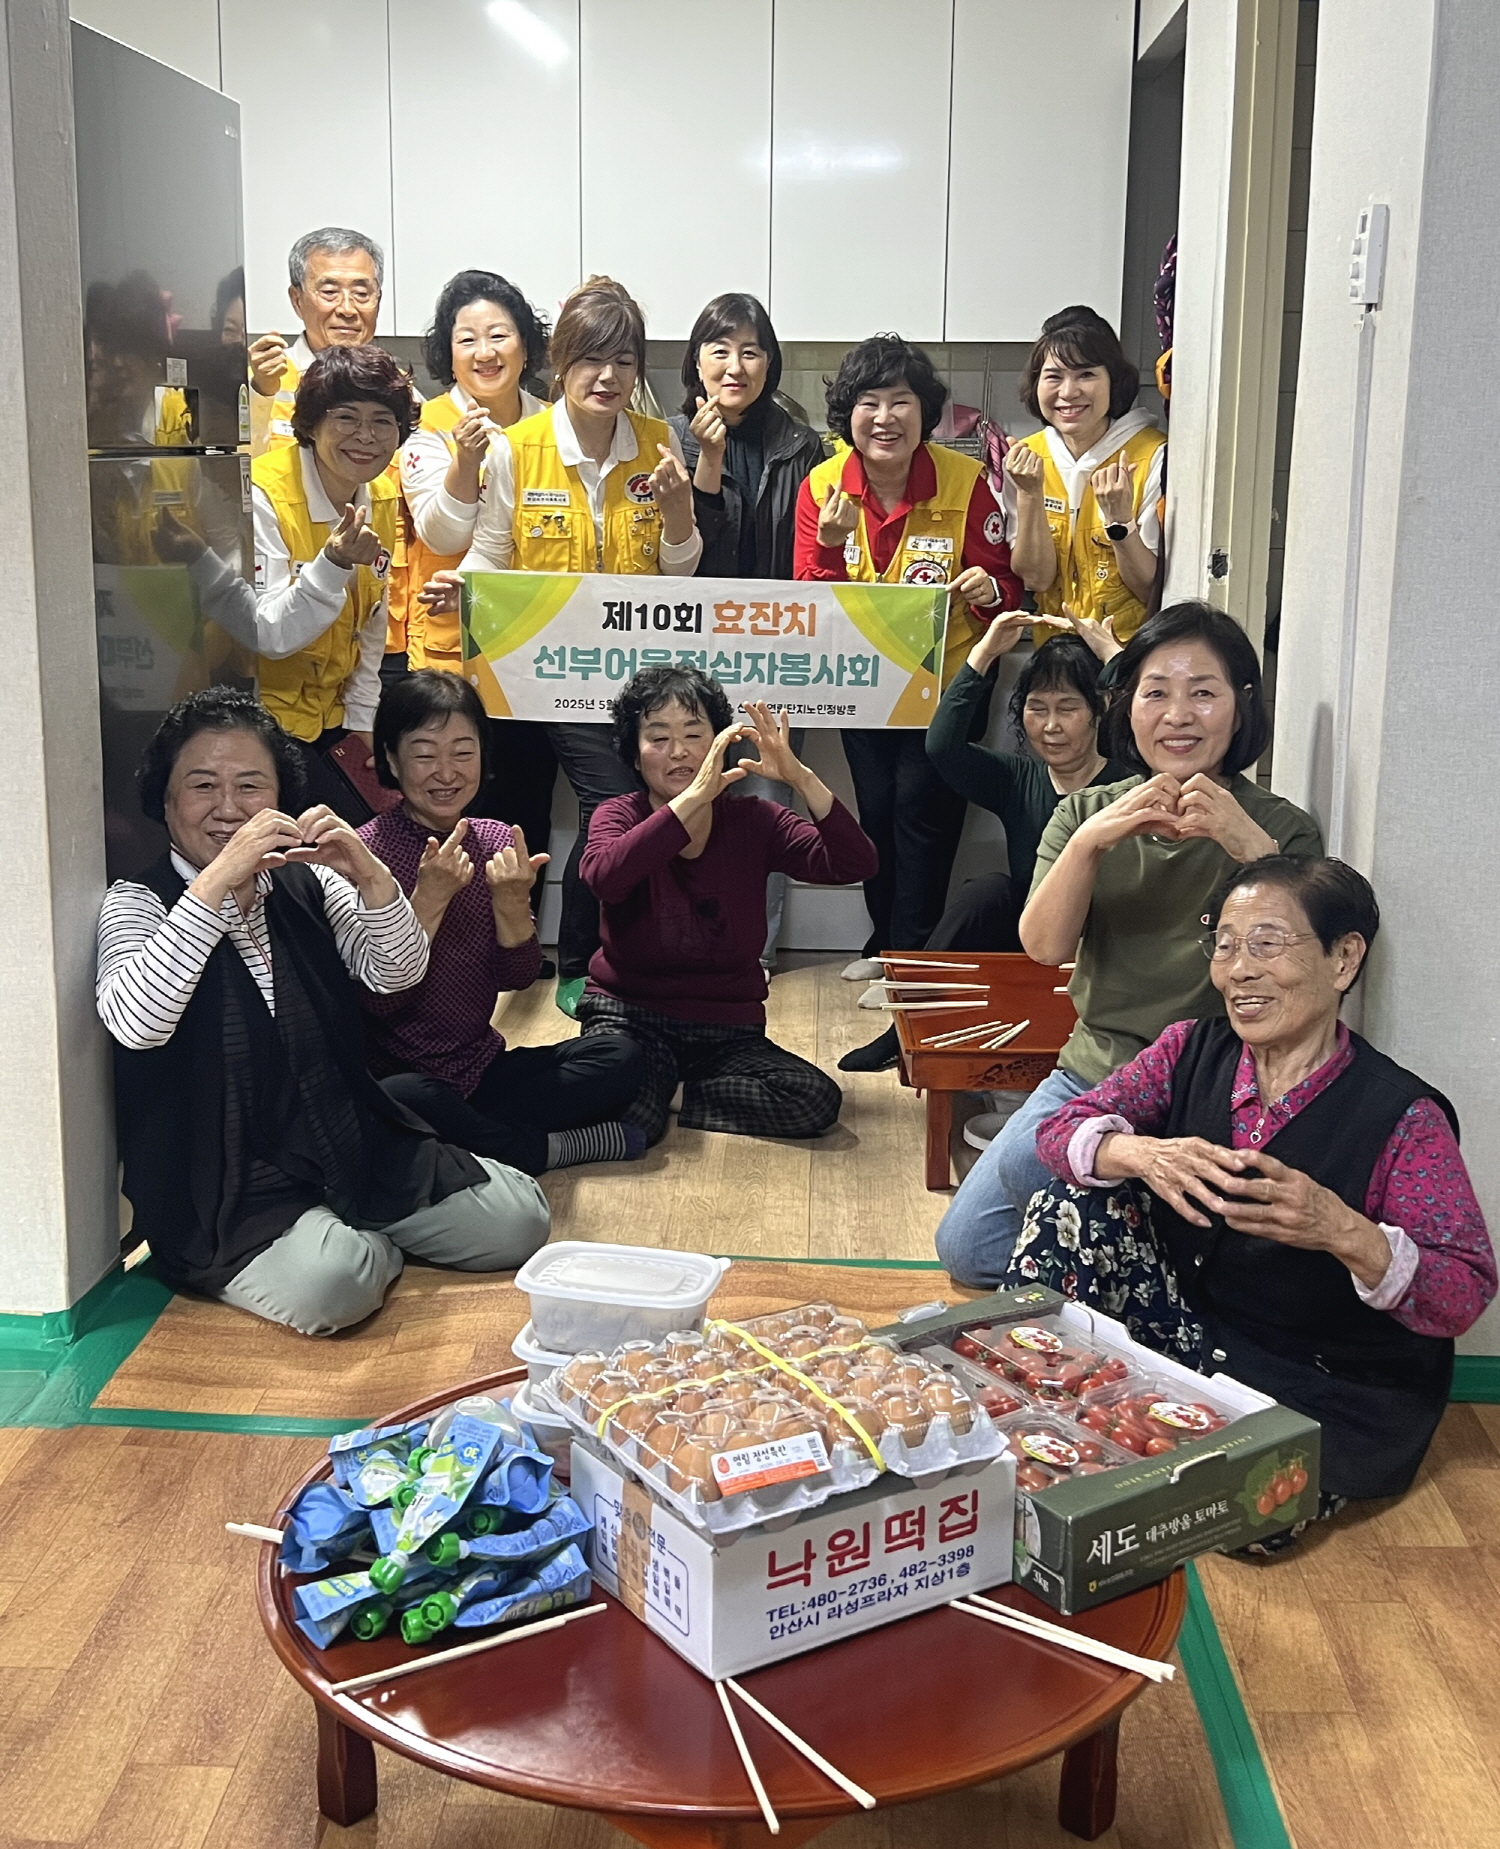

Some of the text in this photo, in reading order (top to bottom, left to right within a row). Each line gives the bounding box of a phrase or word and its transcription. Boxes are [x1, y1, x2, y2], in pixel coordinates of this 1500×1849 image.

[602, 600, 816, 637] 제10회 효잔치
[554, 698, 595, 710] 2025년
[766, 1489, 978, 1590] 낙원떡집
[1086, 1523, 1140, 1565] 세도
[899, 1545, 975, 1579] 482-3398
[769, 1562, 971, 1640] 안산시 라성프라자 지상1층
